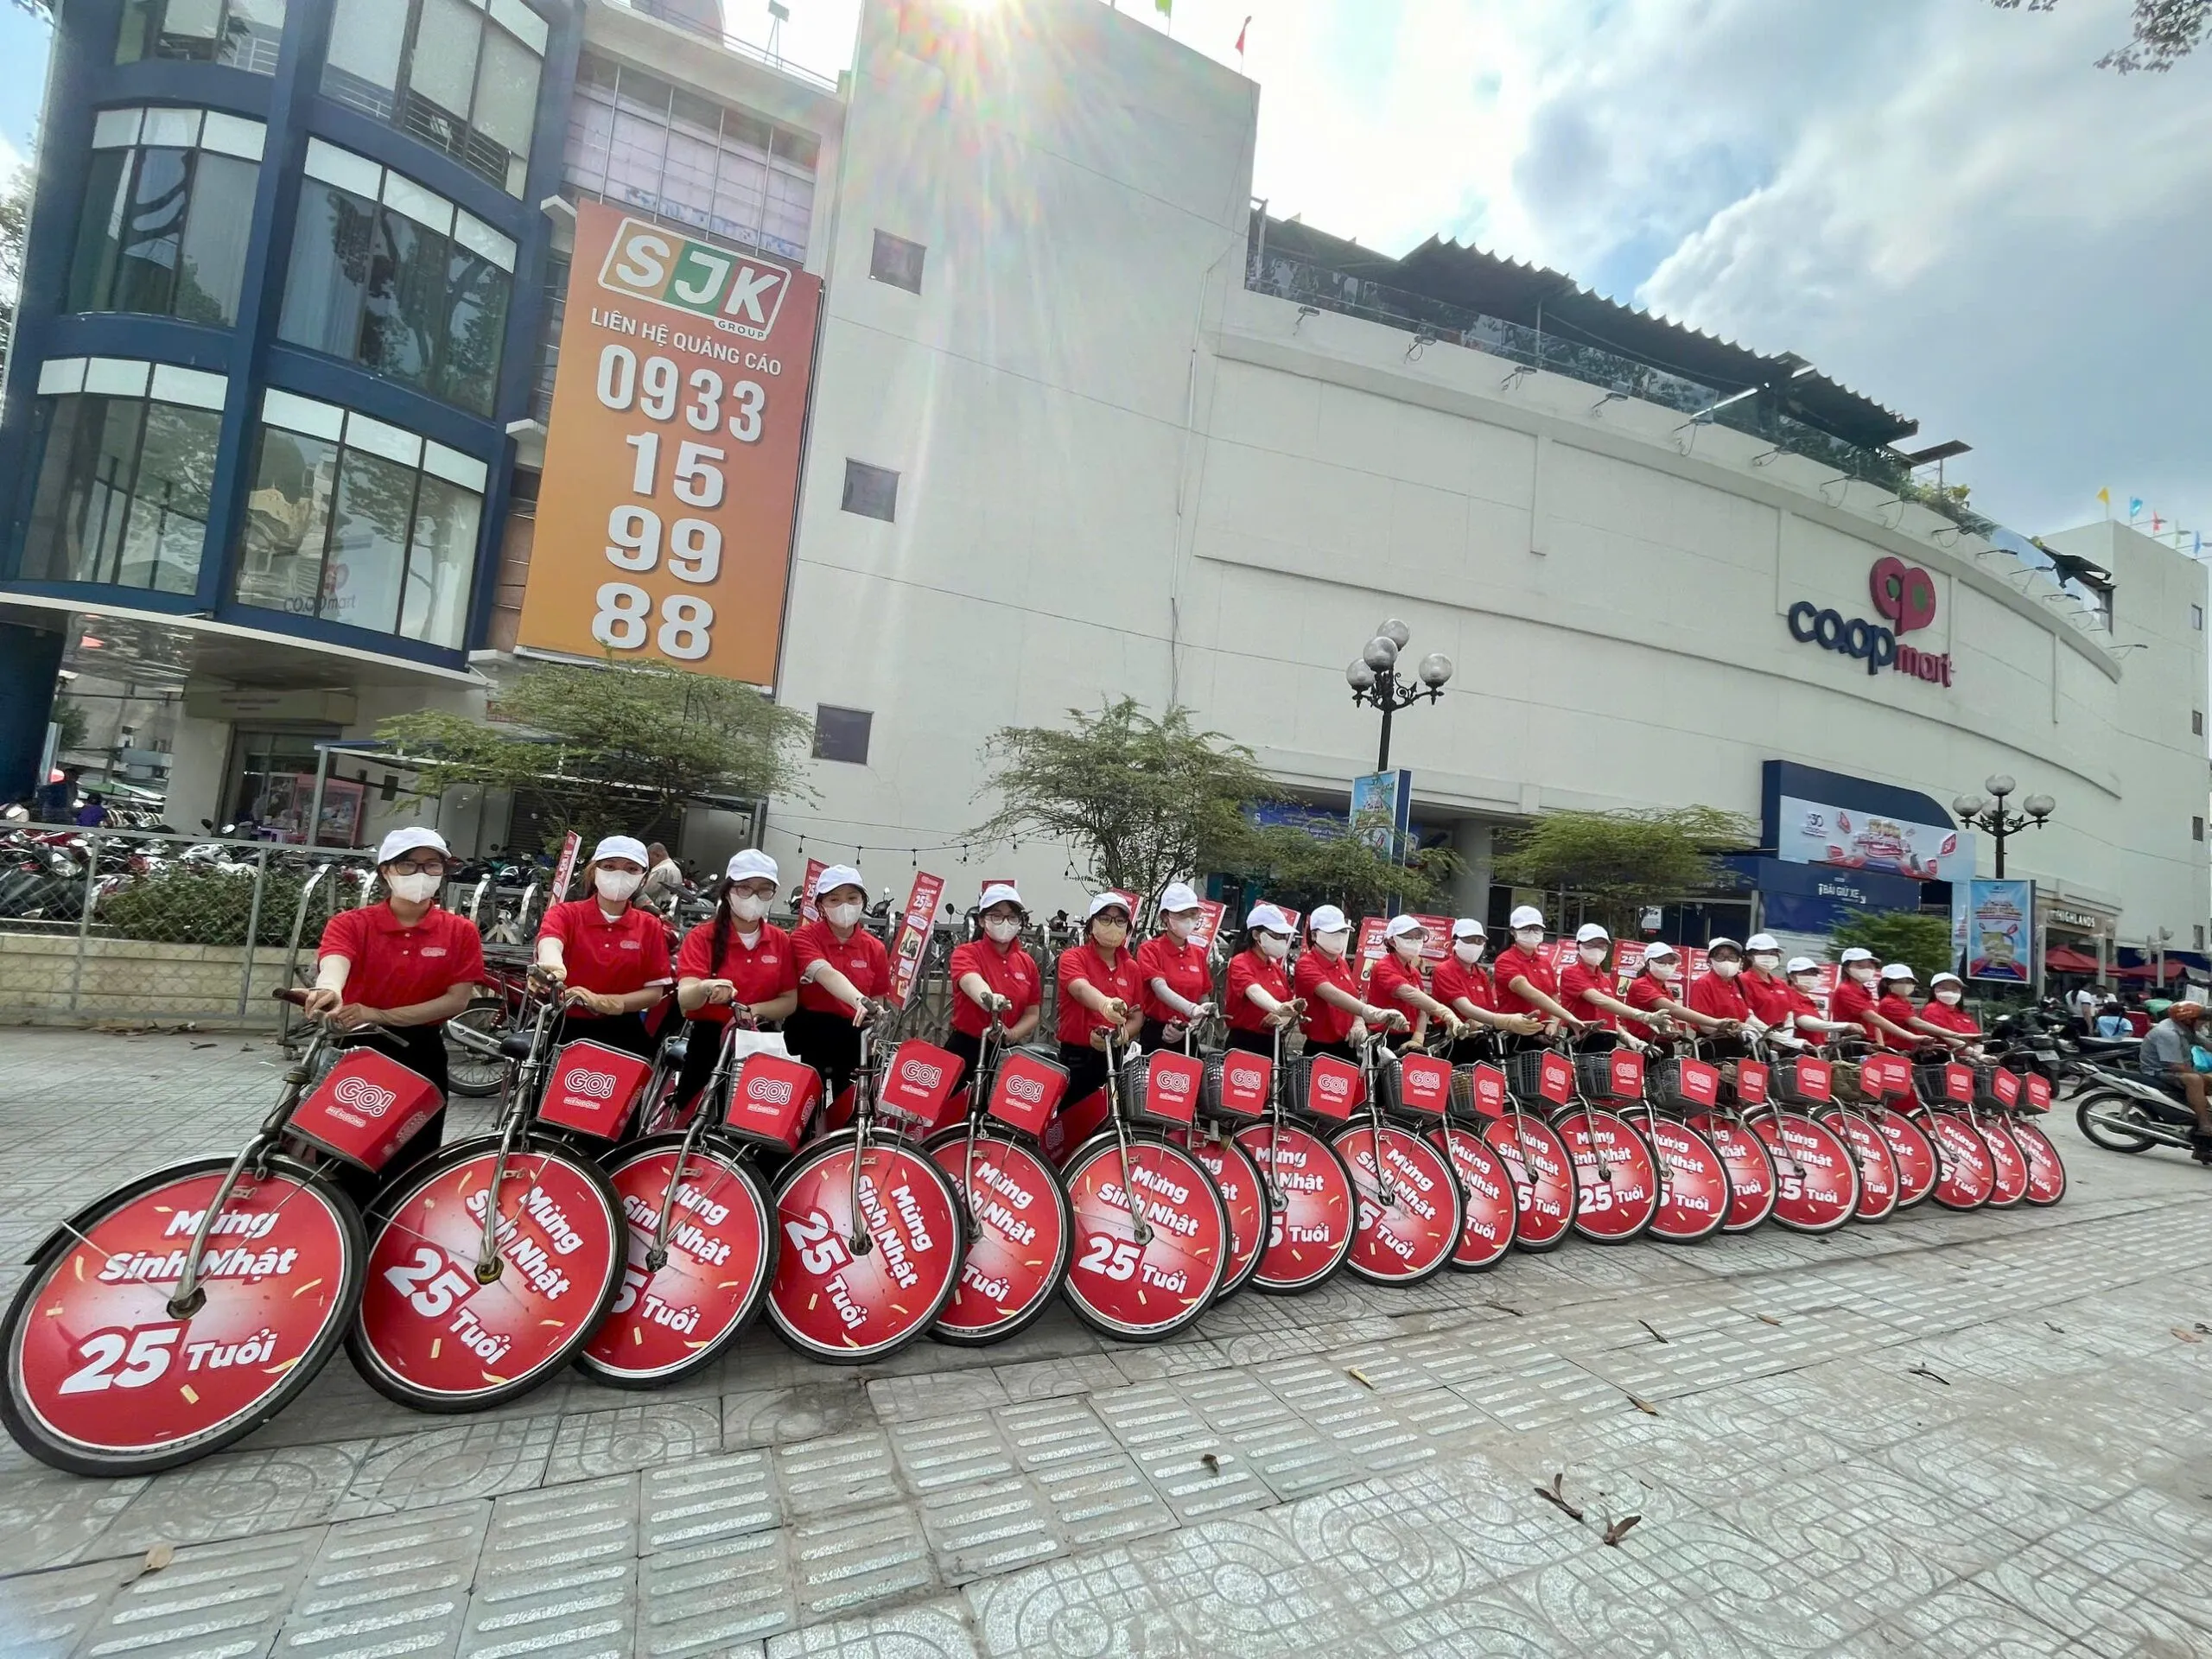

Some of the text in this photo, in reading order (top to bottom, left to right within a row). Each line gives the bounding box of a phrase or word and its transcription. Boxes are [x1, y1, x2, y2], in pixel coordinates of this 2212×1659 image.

[614, 233, 780, 323] SJK
[591, 307, 781, 377] LIÊN HỆ QUẢNG CÁO
[718, 319, 766, 340] GROUP
[596, 343, 766, 443] 0933
[626, 431, 726, 508] 15
[605, 505, 722, 583] 99
[591, 582, 715, 660] 88
[1366, 934, 1384, 946] 25
[1620, 955, 1637, 965] 25
[564, 1068, 617, 1099] GO!
[901, 1059, 943, 1089] GO!
[1006, 1074, 1045, 1103] GO!
[1156, 1070, 1191, 1094] GO!
[1230, 1068, 1262, 1090] GO!
[1318, 1073, 1348, 1096] GO!
[1408, 1070, 1440, 1090] GO!
[1478, 1079, 1500, 1098] GO!
[334, 1076, 397, 1118] GO!
[747, 1077, 793, 1106] GO!
[1878, 1122, 1902, 1139] ng
[1944, 1125, 1978, 1152] Mừng
[1451, 1141, 1492, 1175] Mừng
[1600, 1147, 1632, 1165] Nhật
[1665, 1153, 1705, 1174] Nhật
[1796, 1148, 1833, 1167] Nhật
[1888, 1139, 1915, 1156] hật
[1957, 1146, 1984, 1170] Nhật
[1385, 1148, 1434, 1192] Mừng
[1531, 1154, 1560, 1177] Nhật
[1940, 1163, 1979, 1197] 5 Tuổi
[975, 1161, 1034, 1210] Mừng
[1131, 1166, 1190, 1205] Mừng
[1279, 1172, 1325, 1194] Nhật
[1467, 1170, 1502, 1200] Nhật
[1659, 1183, 1709, 1211] 5 Tuổi
[1733, 1178, 1763, 1197] Tuổi
[1778, 1177, 1838, 1204] 5 Tuổi
[1866, 1180, 1887, 1195] Tuổi
[2030, 1173, 2052, 1192] Tuổi
[660, 1183, 730, 1226] Mừng
[1097, 1182, 1199, 1236] Sinh Nhật
[1394, 1180, 1437, 1221] Nhật
[1517, 1184, 1560, 1217] 5 Tuổi
[1579, 1183, 1644, 1215] 25 Tuổi
[519, 1185, 584, 1255] Mừng
[858, 1175, 918, 1290] Sinh Nhật
[891, 1185, 933, 1253] Mừng
[982, 1202, 1036, 1246] Nhật
[1268, 1216, 1284, 1248] 5
[1289, 1222, 1330, 1243] Tuổi
[1358, 1200, 1416, 1261] 5 Tuổi
[1466, 1215, 1497, 1242] Tuổi
[671, 1220, 731, 1266] Nhật
[96, 1247, 299, 1281] Sinh Nhật
[507, 1236, 571, 1300] Nhật
[785, 1211, 868, 1330] 25 Tuổi
[1078, 1236, 1188, 1294] 25 Tuổi
[962, 1264, 1011, 1303] Tuổi
[383, 1248, 512, 1365] 25 Tuổi
[611, 1268, 701, 1335] 5 Tuổi
[58, 1326, 278, 1395] 25 Tuổi
